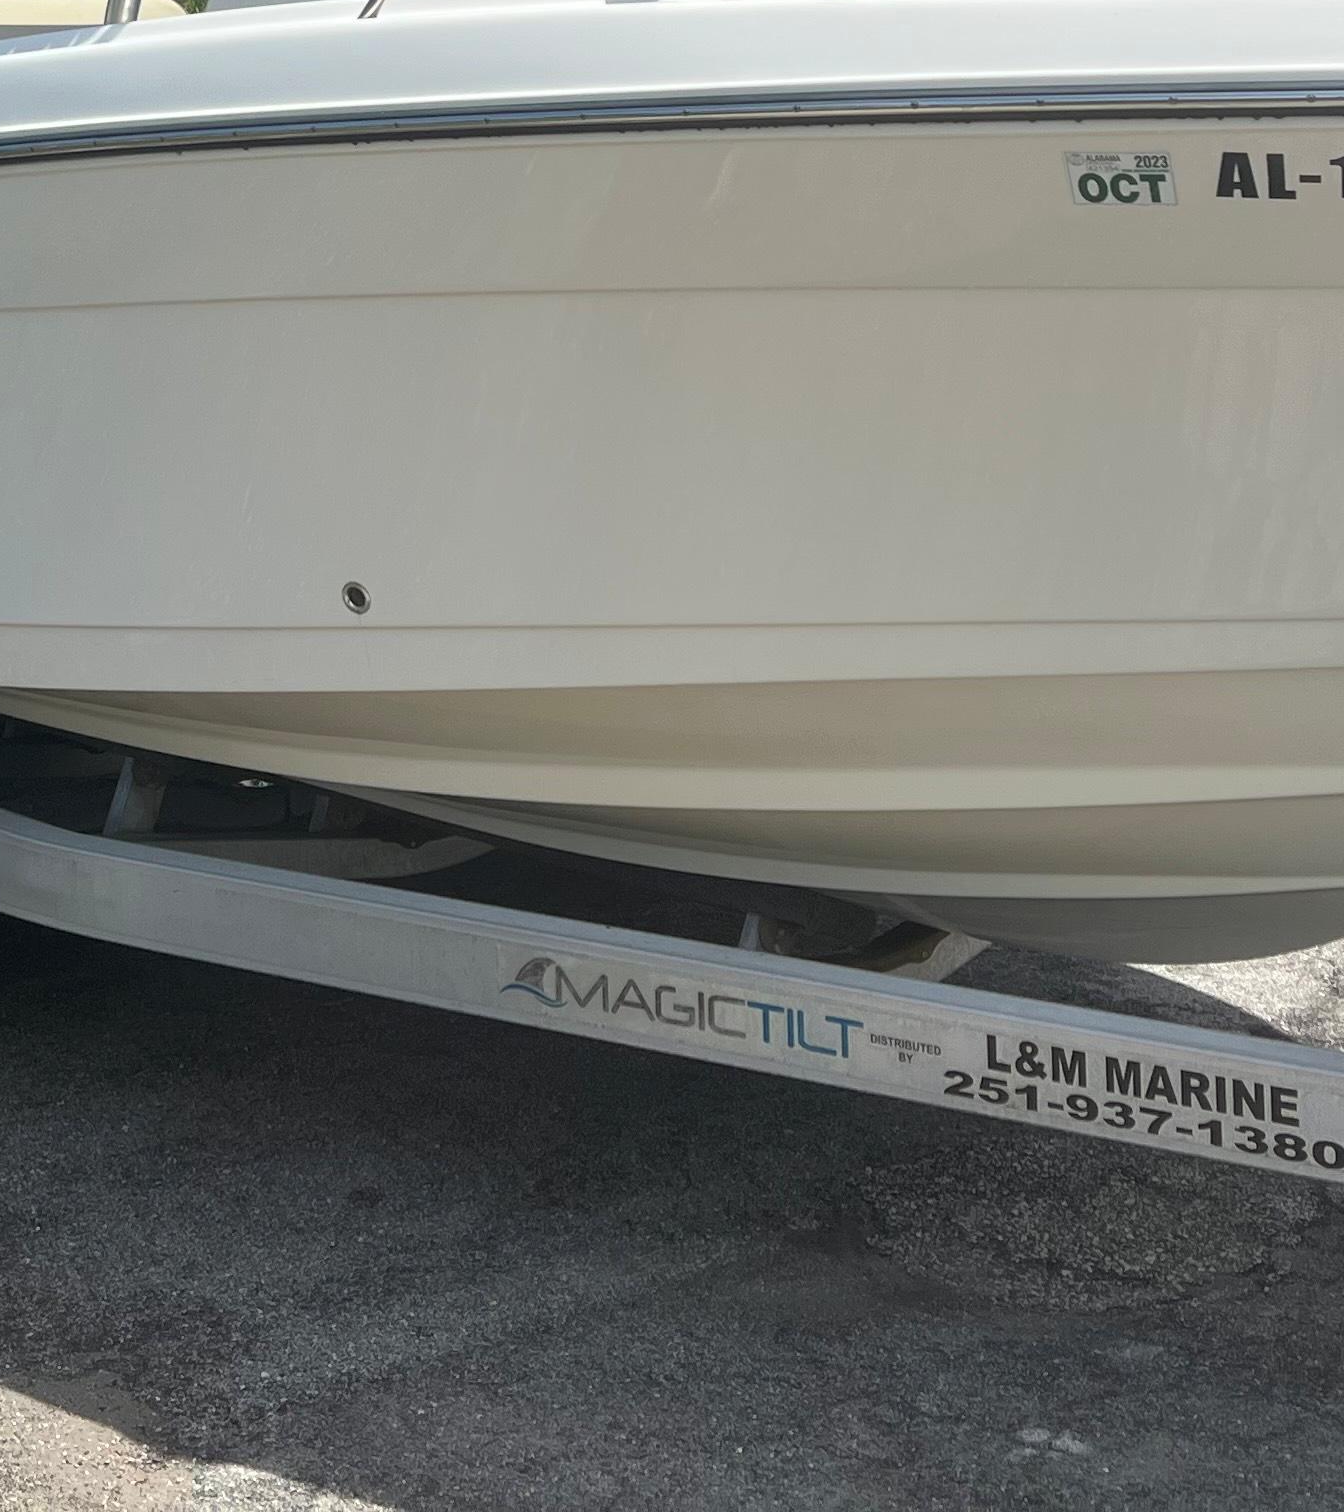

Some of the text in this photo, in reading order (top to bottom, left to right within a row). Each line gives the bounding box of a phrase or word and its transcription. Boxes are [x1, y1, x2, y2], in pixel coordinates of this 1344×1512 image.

[1134, 155, 1169, 168] 2023
[1078, 173, 1163, 203] OCT
[870, 1033, 942, 1057] DISTRIBUTED
[898, 1052, 913, 1065] BY
[986, 1034, 1301, 1127] L&M MARINE
